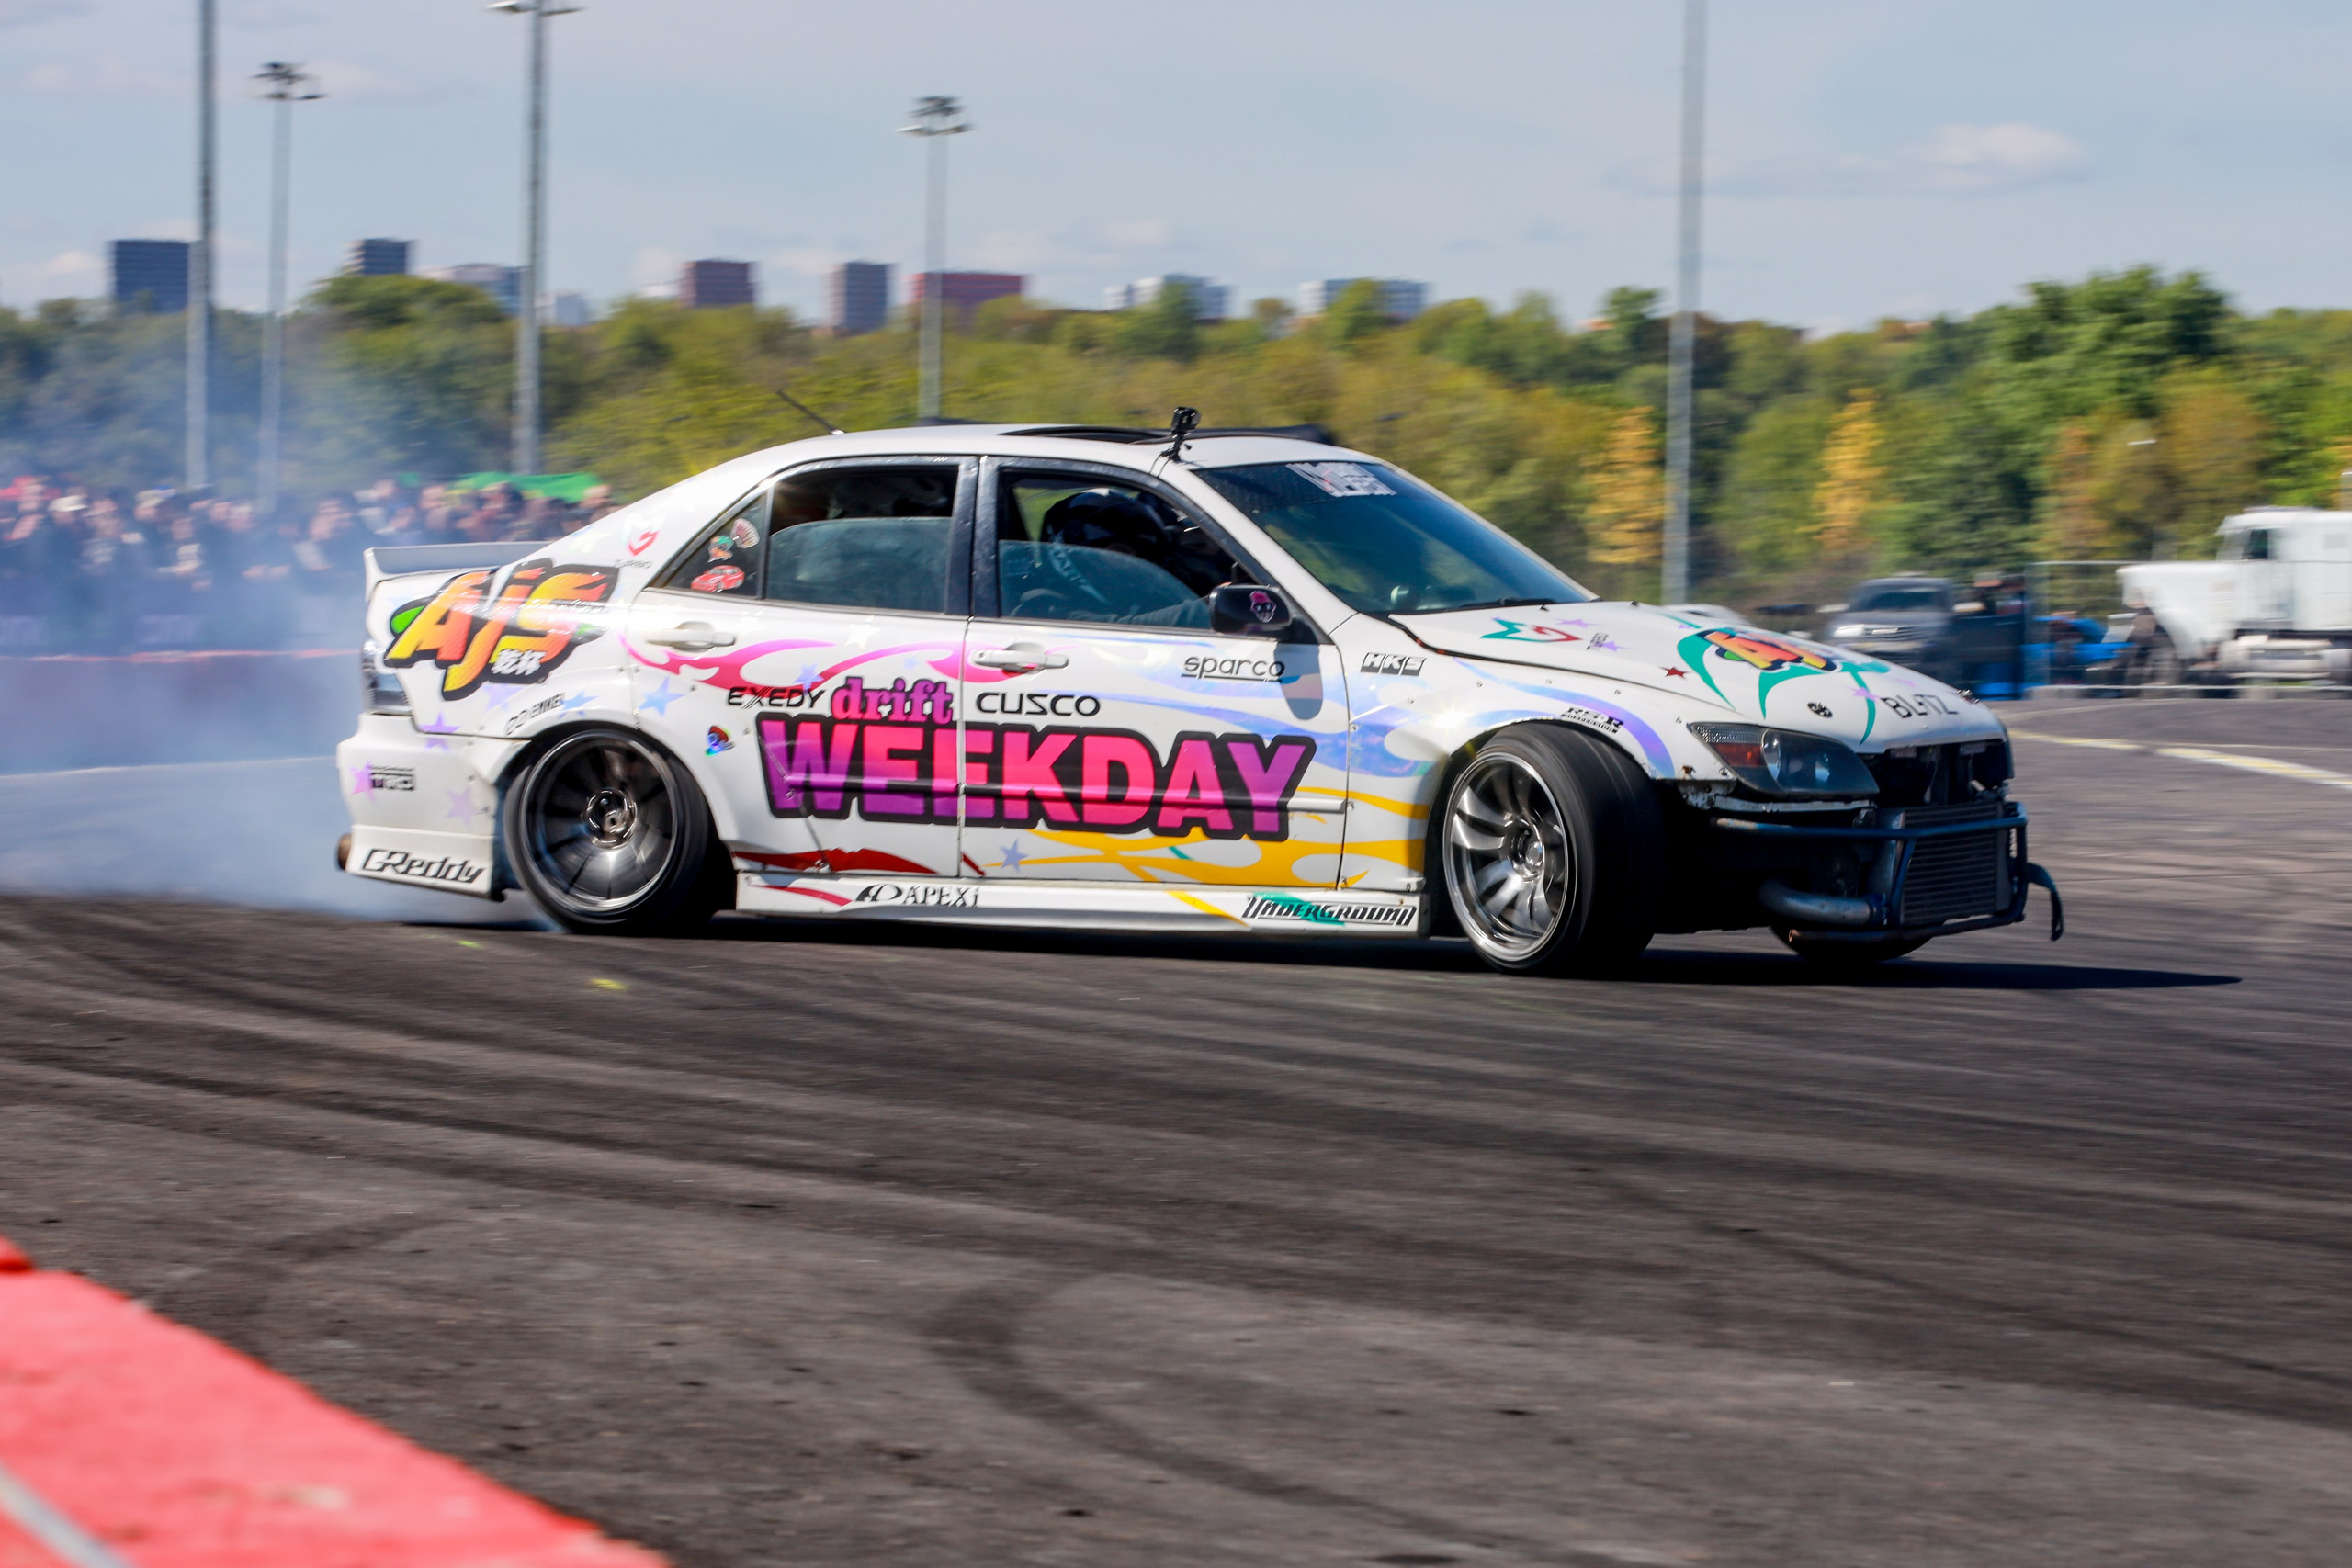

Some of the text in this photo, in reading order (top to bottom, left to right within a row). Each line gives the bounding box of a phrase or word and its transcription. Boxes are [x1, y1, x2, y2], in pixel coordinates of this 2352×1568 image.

[1183, 654, 1285, 678] sparco
[1361, 652, 1425, 676] HKS
[727, 686, 826, 710] EXEDY
[831, 676, 953, 725] drift
[976, 692, 1101, 716] CUSCO
[758, 716, 1310, 838] WEEKDAY
